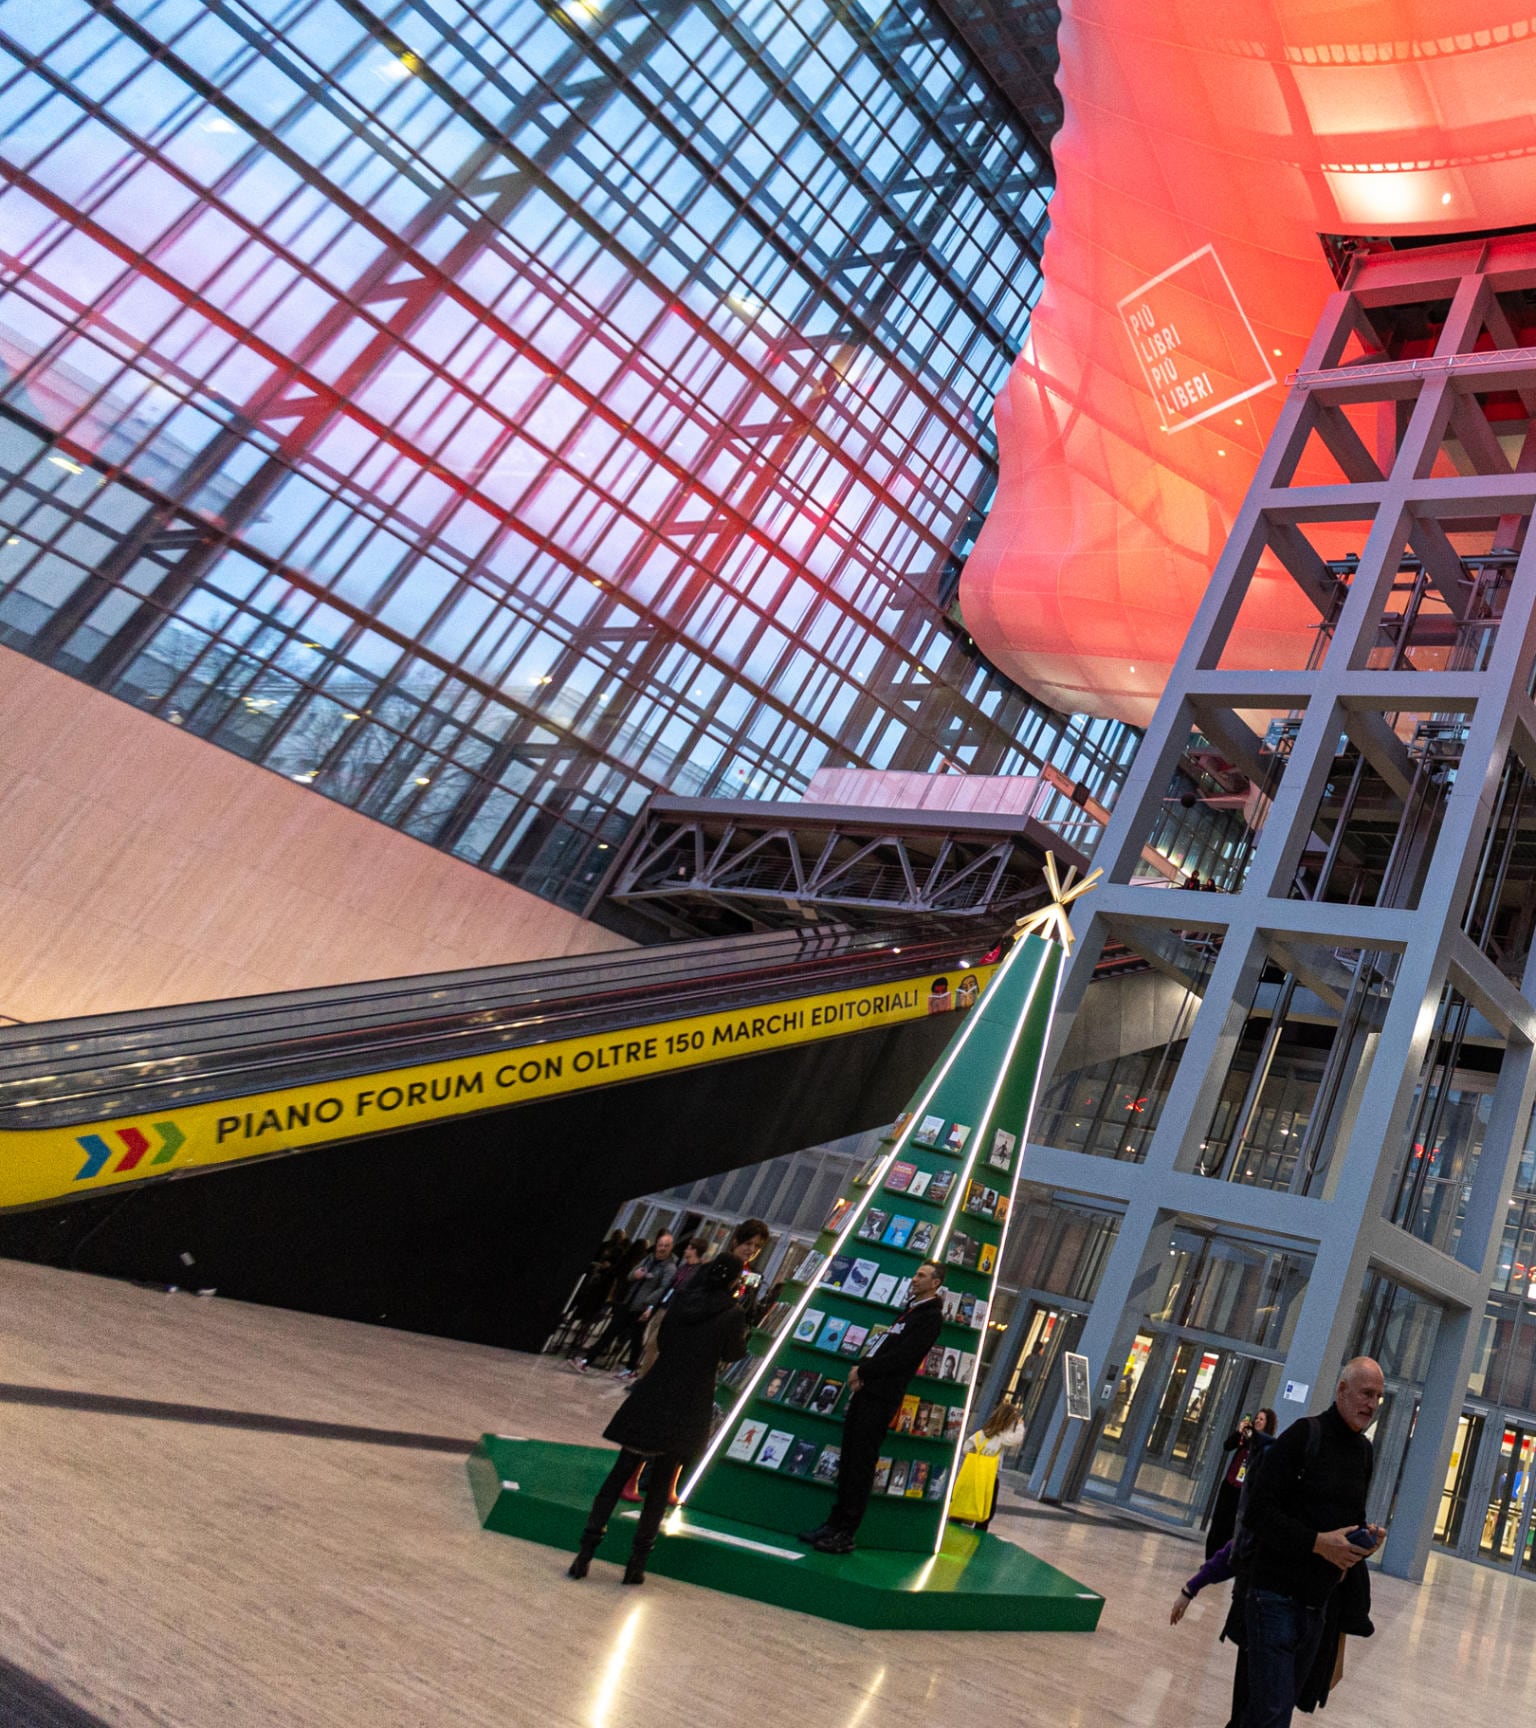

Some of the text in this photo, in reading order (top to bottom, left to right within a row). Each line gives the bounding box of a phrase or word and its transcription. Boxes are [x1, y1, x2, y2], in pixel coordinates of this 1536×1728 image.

[1129, 303, 1156, 337] PIÙ
[1140, 323, 1182, 363] LIBRI
[1151, 356, 1179, 389] PIÙ
[1161, 372, 1214, 415] LIBERI
[216, 989, 919, 1144] PIANO FORUM CON OLTRE 150 MARCHI EDITORIALI
